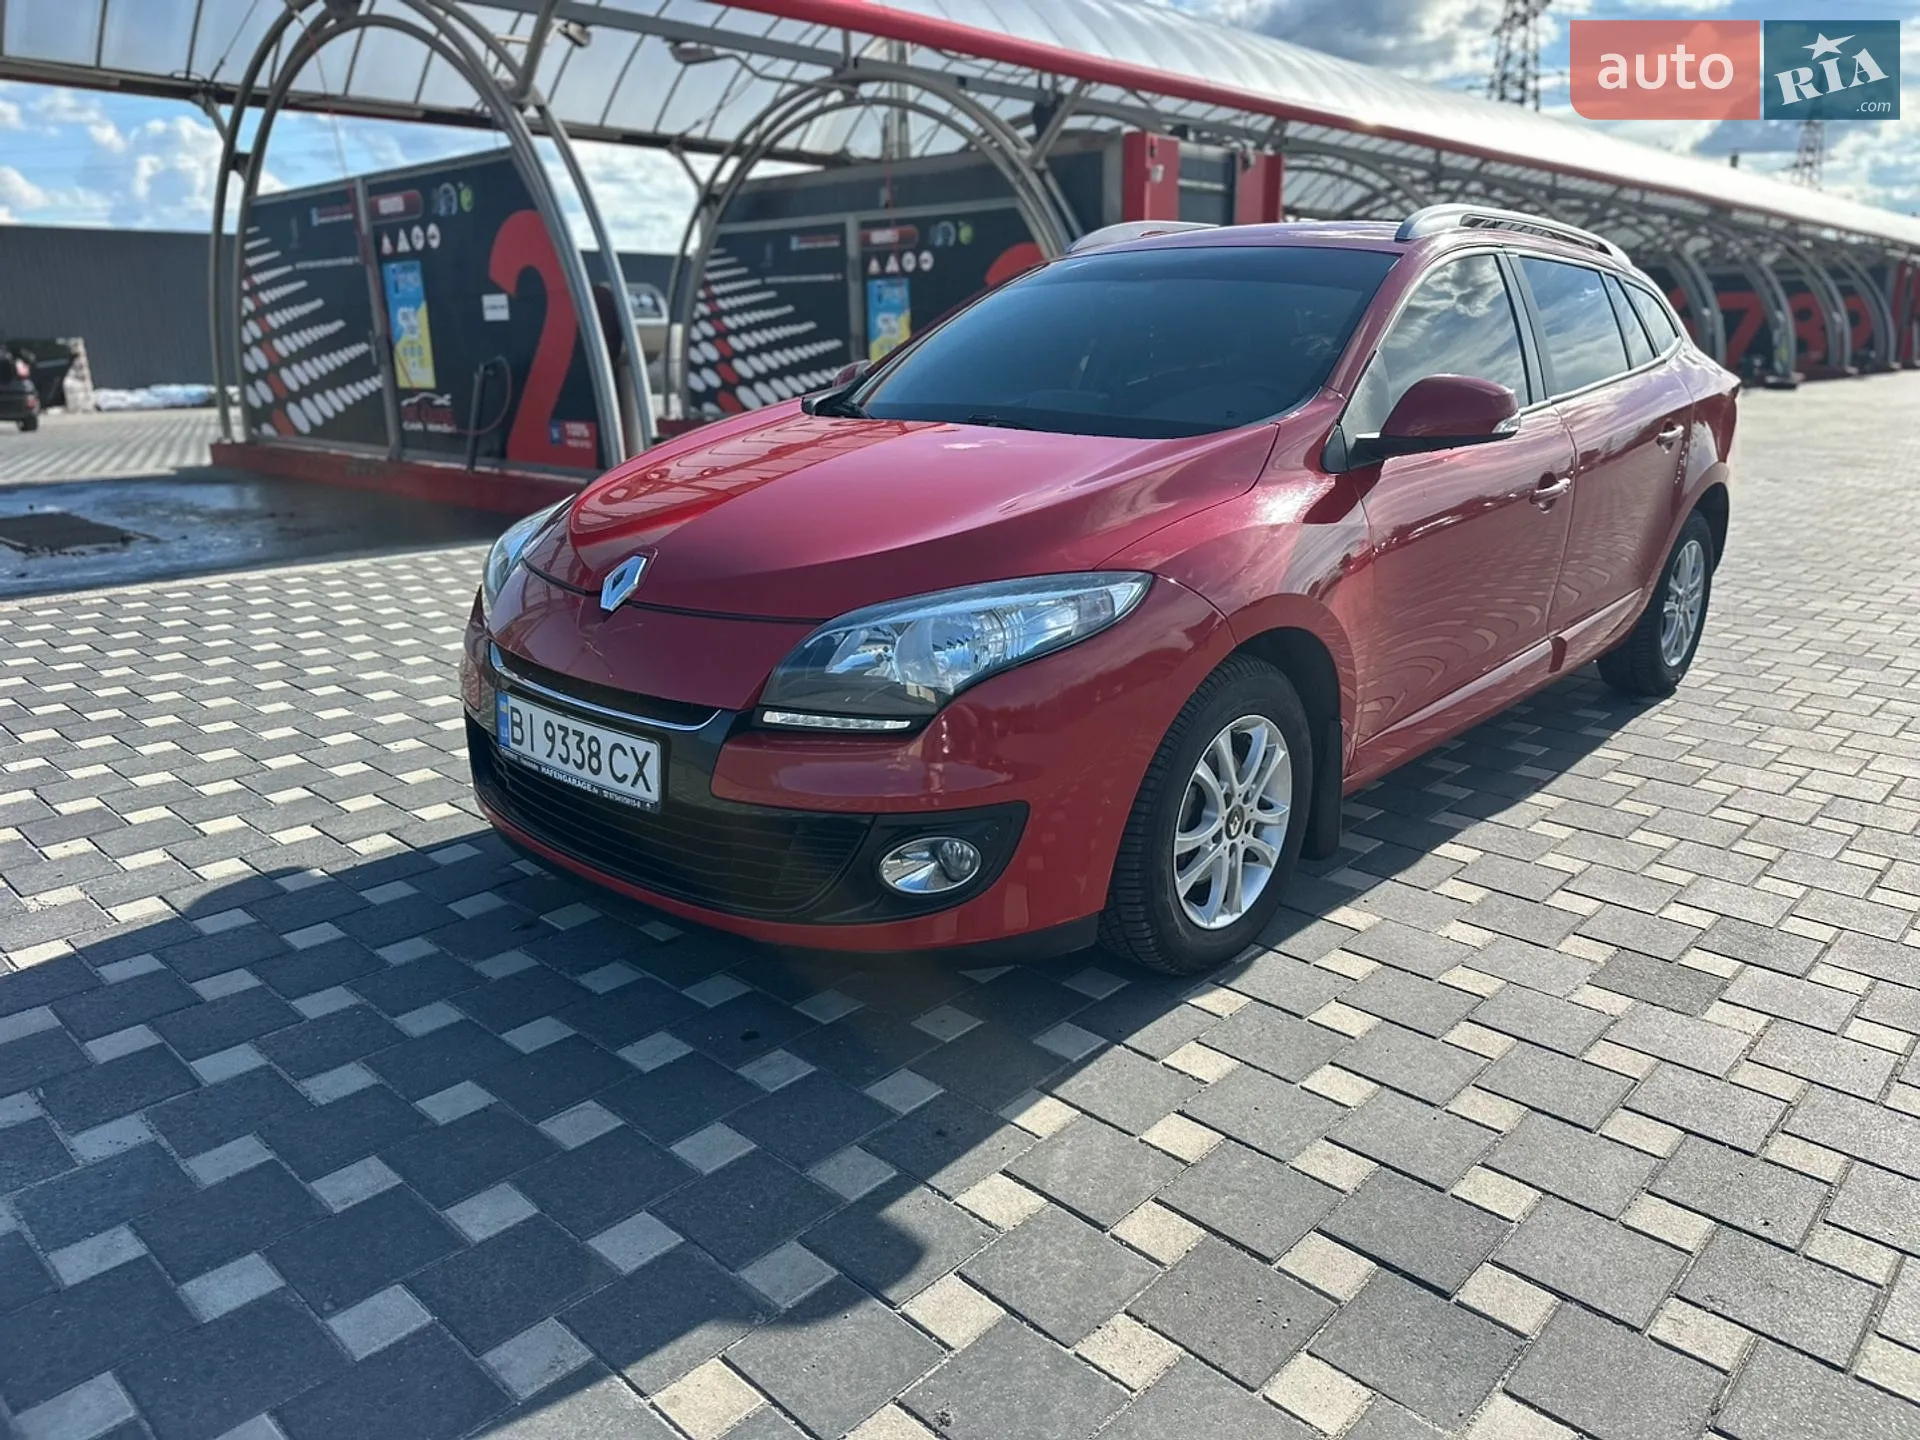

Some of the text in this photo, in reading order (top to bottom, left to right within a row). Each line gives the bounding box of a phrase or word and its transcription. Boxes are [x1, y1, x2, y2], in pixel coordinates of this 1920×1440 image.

[488, 209, 598, 469] 2
[510, 706, 535, 752] BI
[543, 720, 603, 775] 9338
[608, 742, 652, 793] CX
